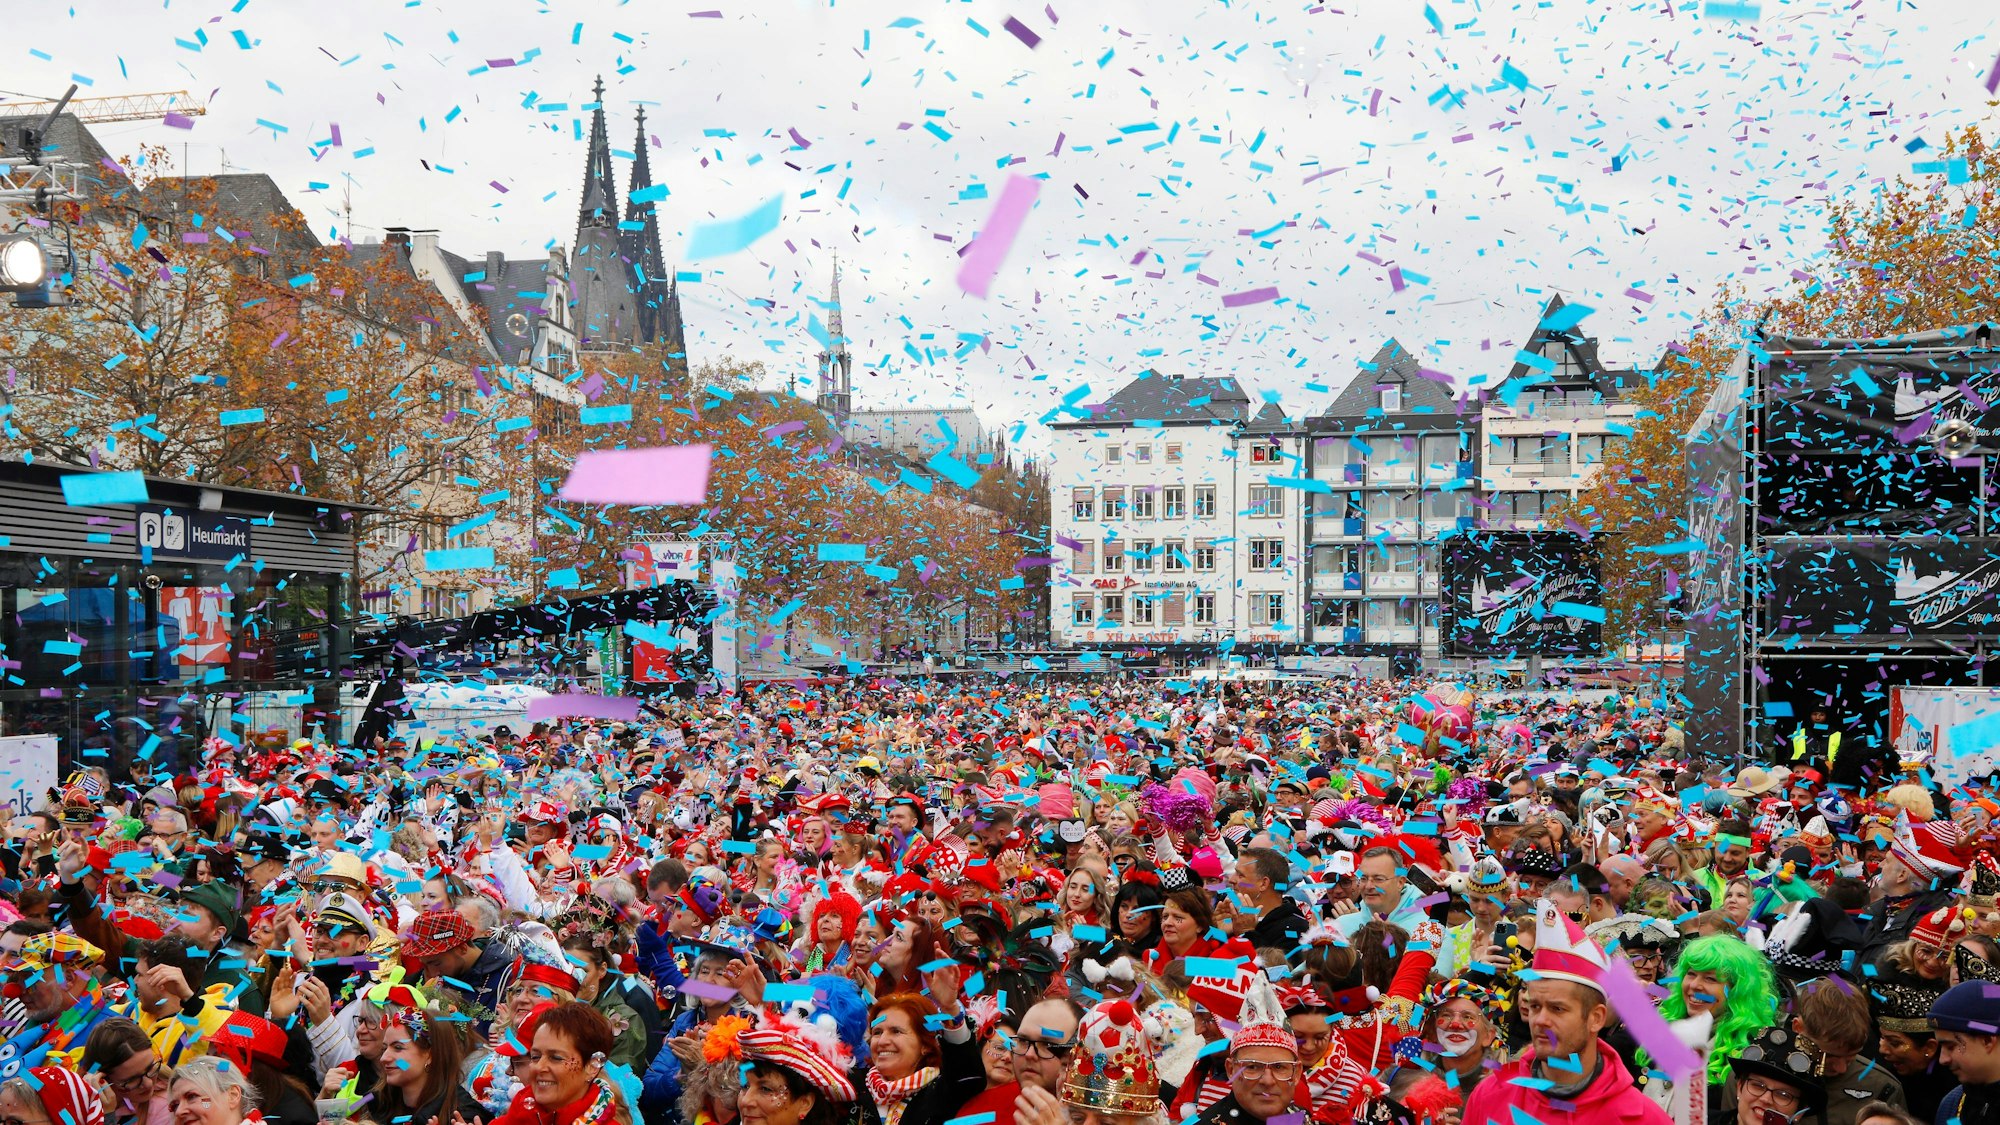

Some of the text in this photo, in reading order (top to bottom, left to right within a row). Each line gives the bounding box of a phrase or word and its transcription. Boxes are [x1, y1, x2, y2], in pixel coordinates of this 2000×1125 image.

[192, 526, 246, 546] Heumarkt
[663, 552, 683, 560] WDR
[1093, 578, 1117, 589] GAG
[1187, 580, 1197, 588] AG
[1249, 634, 1283, 643] HOTEL
[433, 930, 454, 940] BRINGS
